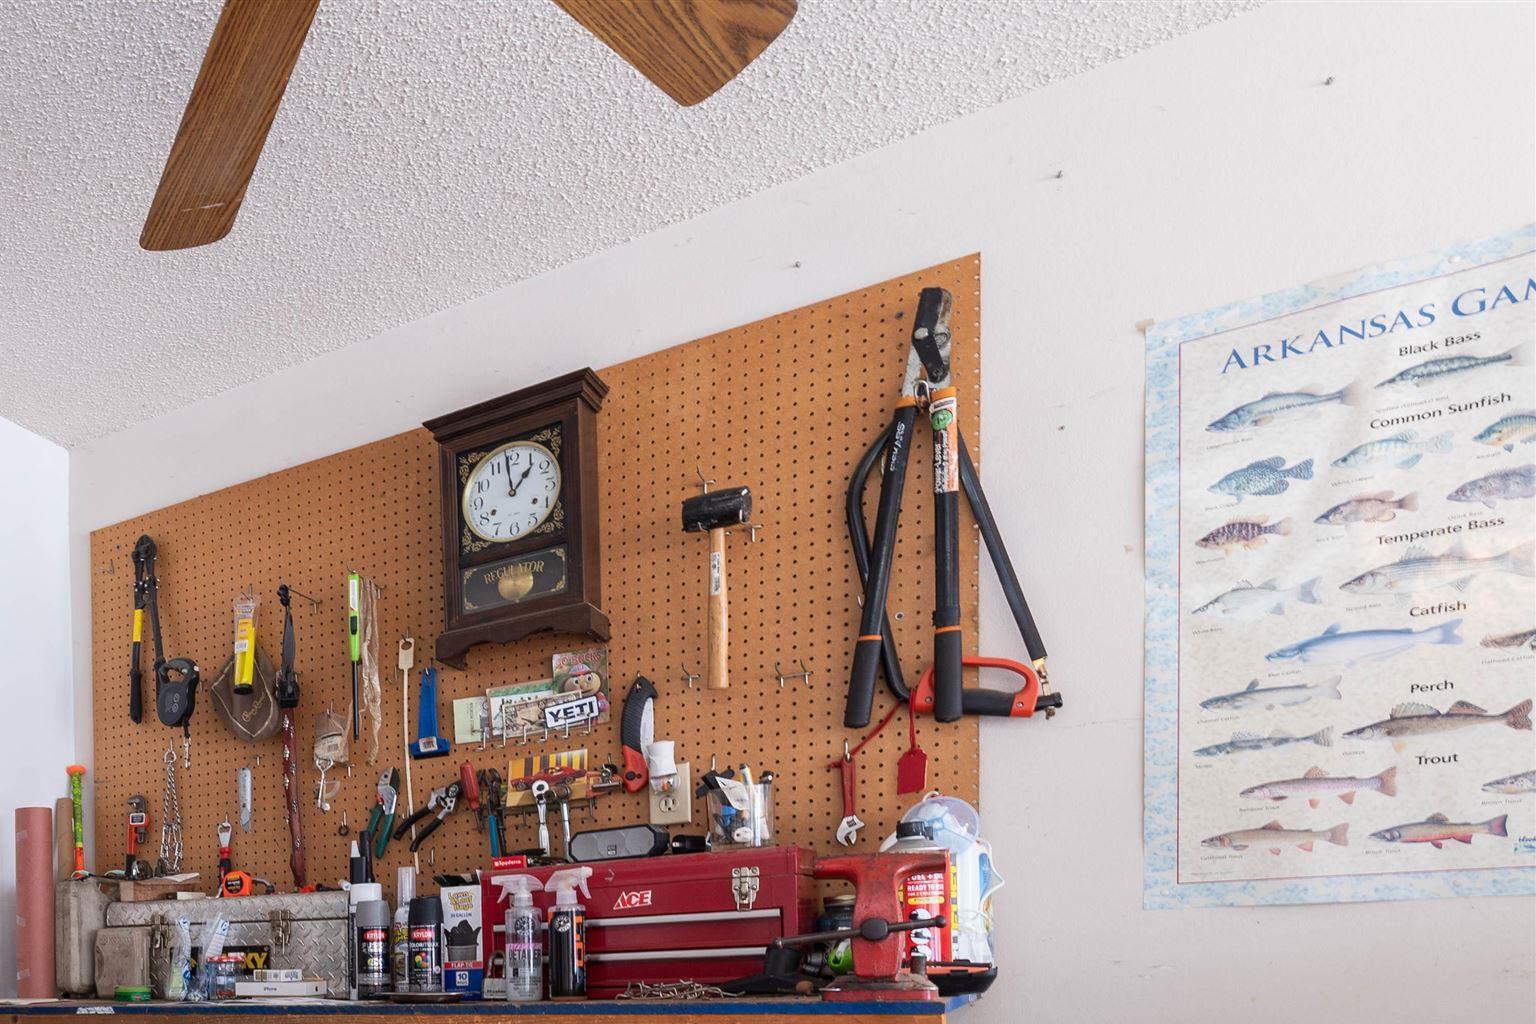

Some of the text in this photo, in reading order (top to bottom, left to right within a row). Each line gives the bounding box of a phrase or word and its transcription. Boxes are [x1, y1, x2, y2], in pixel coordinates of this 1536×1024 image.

[1221, 303, 1436, 374] ARKANSAS
[1398, 331, 1482, 357] Black Bass
[1370, 409, 1442, 429] Common
[1448, 392, 1512, 415] Sunfish
[490, 461, 501, 476] 11
[538, 459, 550, 474] 2
[475, 479, 490, 493] 10
[473, 496, 484, 510] 9
[479, 511, 490, 526] 8
[493, 522, 502, 536] 7
[510, 521, 520, 536] 6
[1376, 517, 1505, 546] Temperate Bass
[1409, 601, 1468, 618] Catfish
[1410, 680, 1455, 694] Perch
[549, 701, 596, 723] YETI
[1415, 753, 1459, 766] Trout
[613, 890, 652, 910] ACE
